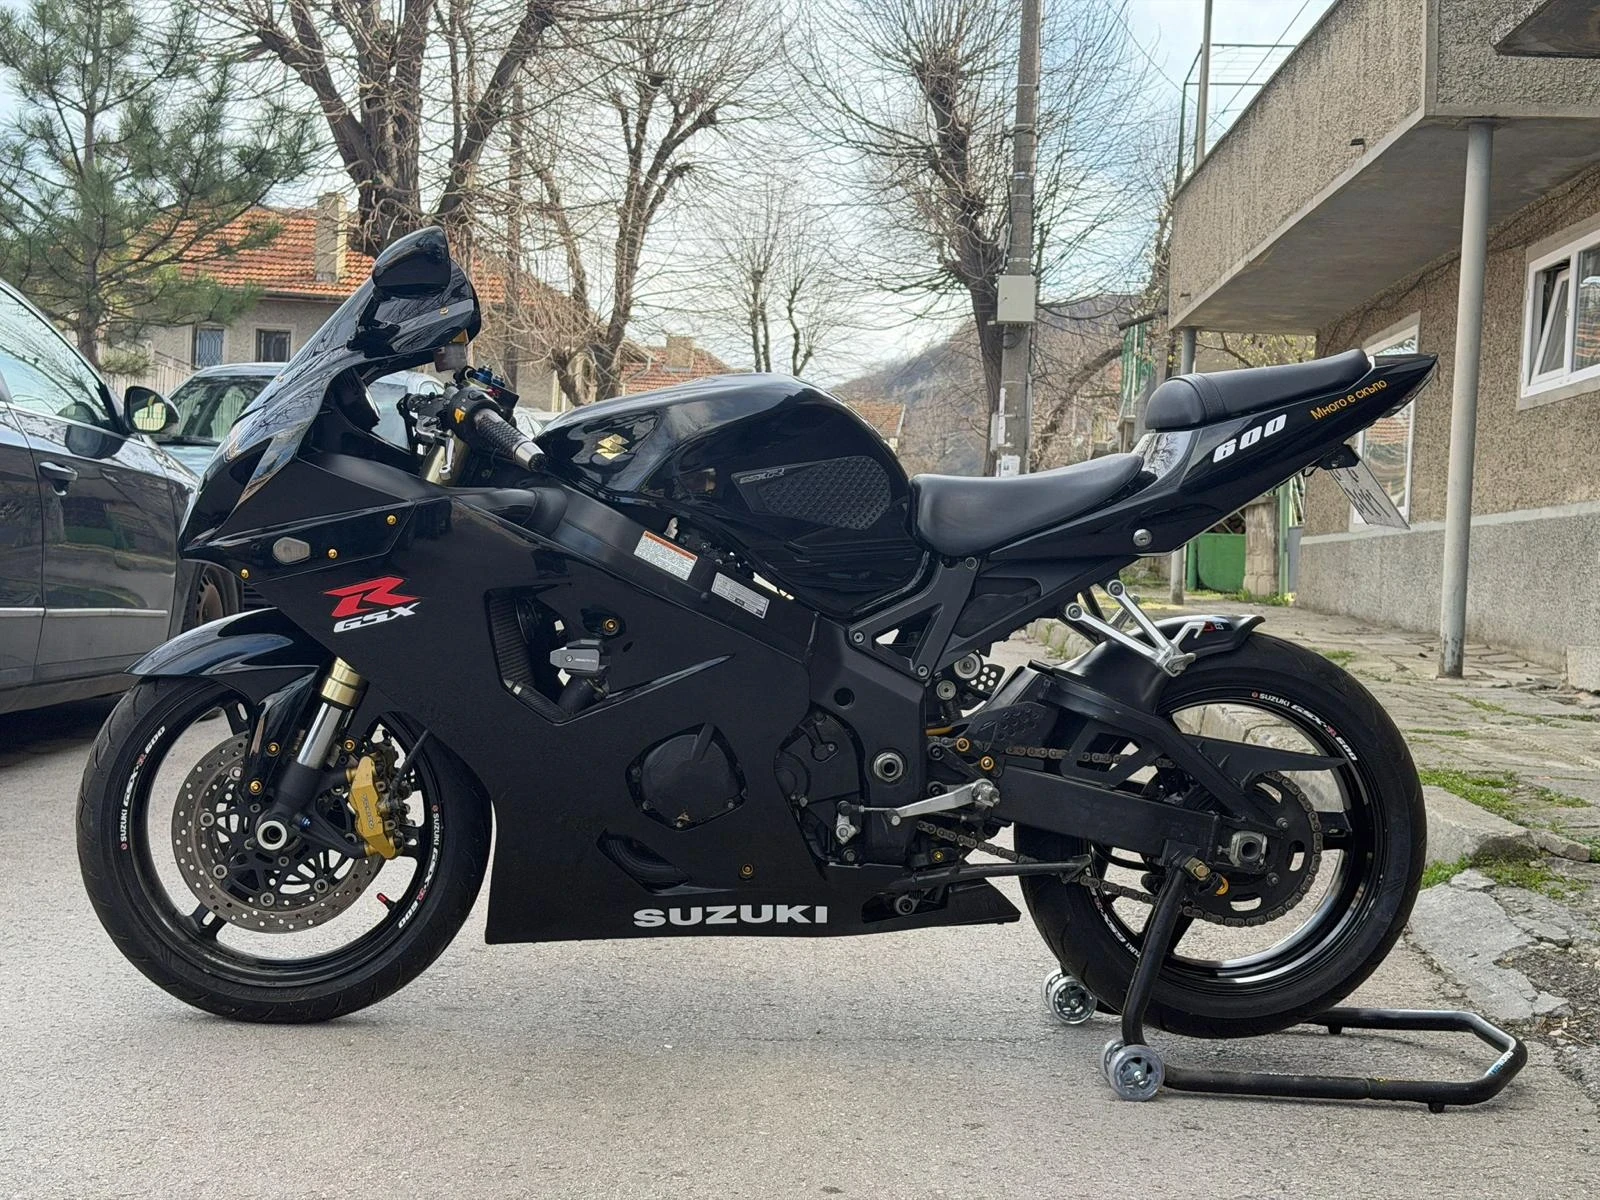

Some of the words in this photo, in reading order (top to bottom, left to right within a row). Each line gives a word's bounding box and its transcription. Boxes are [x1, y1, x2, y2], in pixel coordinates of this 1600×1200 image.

[1310, 398, 1347, 420] Много
[1347, 394, 1356, 403] е
[1355, 380, 1388, 399] скъпо
[1213, 414, 1287, 463] 600
[333, 602, 421, 633] GSX
[1259, 693, 1290, 707] SUZUKI
[1335, 736, 1358, 761] 600
[120, 809, 128, 842] SUZUKI
[145, 725, 166, 754] 600
[432, 813, 440, 846] SUZUKI
[398, 900, 418, 929] 600
[633, 904, 828, 928] SUZUKI
[1125, 942, 1141, 958] ZUKI
